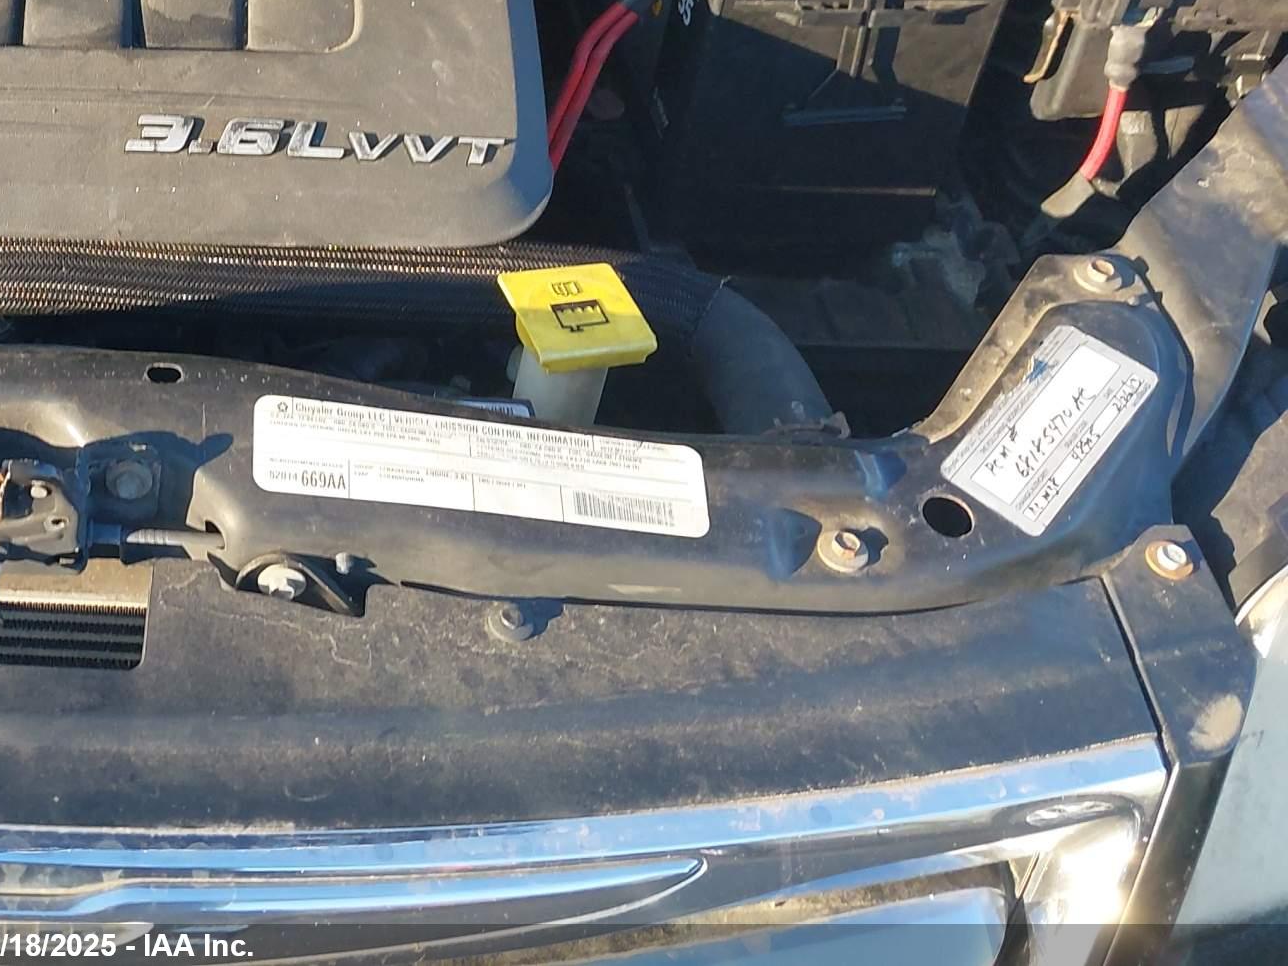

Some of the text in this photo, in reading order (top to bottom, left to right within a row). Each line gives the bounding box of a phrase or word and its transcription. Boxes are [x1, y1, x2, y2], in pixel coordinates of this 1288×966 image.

[124, 113, 507, 166] 3.6L VVT
[295, 402, 386, 421] Chrysler Group LLC
[393, 412, 431, 427] VEHICLE
[434, 418, 479, 434] EMISSION
[481, 425, 522, 440] CONTROL
[526, 432, 591, 448] INFORMATION
